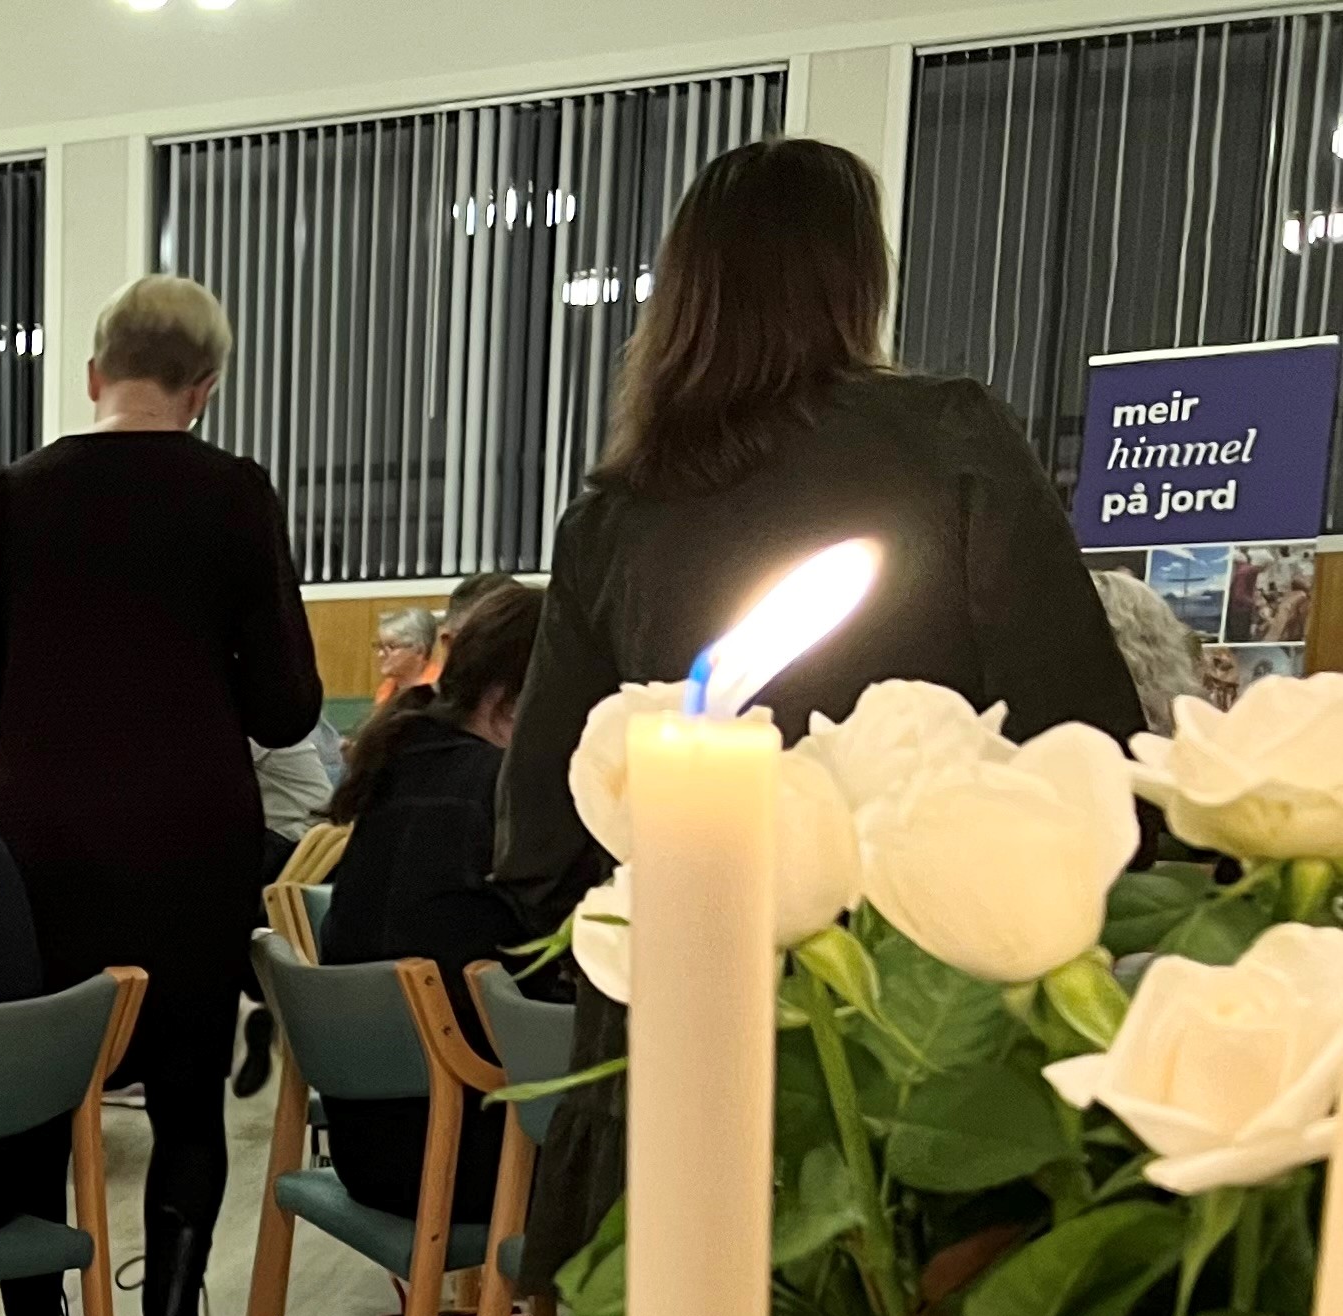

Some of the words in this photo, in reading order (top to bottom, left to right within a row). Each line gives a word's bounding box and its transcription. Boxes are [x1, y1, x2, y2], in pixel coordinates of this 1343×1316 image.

[1112, 390, 1200, 428] meir
[1106, 427, 1258, 471] himmel
[1101, 482, 1149, 523] på
[1154, 479, 1237, 520] jord
